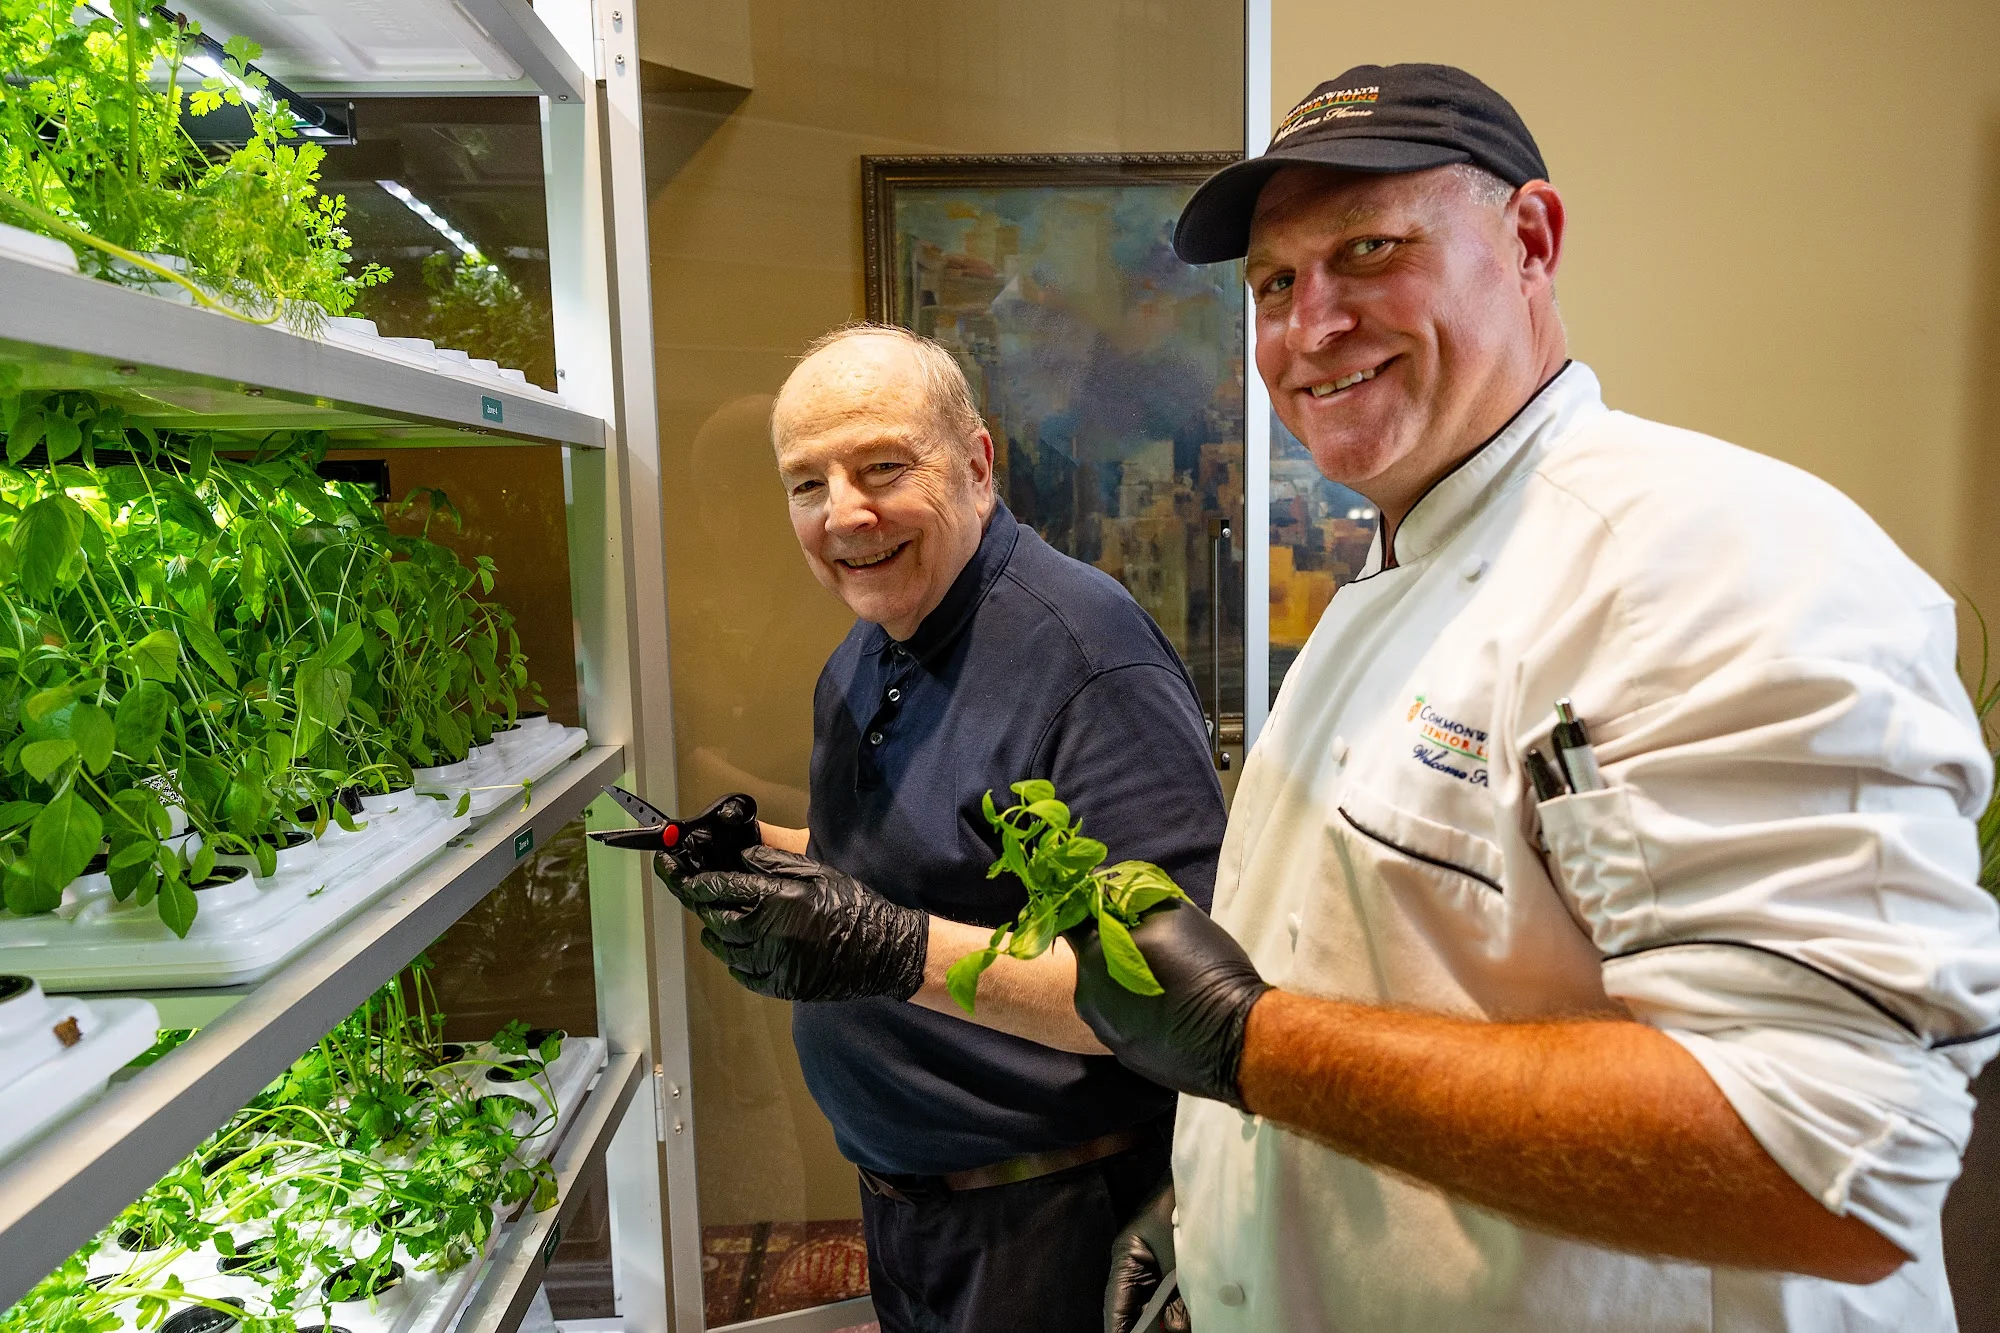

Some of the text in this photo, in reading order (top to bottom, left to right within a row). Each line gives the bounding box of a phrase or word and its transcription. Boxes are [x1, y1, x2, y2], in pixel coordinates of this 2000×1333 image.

[1327, 93, 1378, 105] LIVING
[1323, 105, 1374, 121] Home
[1420, 705, 1488, 744] COMMONW
[1413, 745, 1467, 779] Welcome
